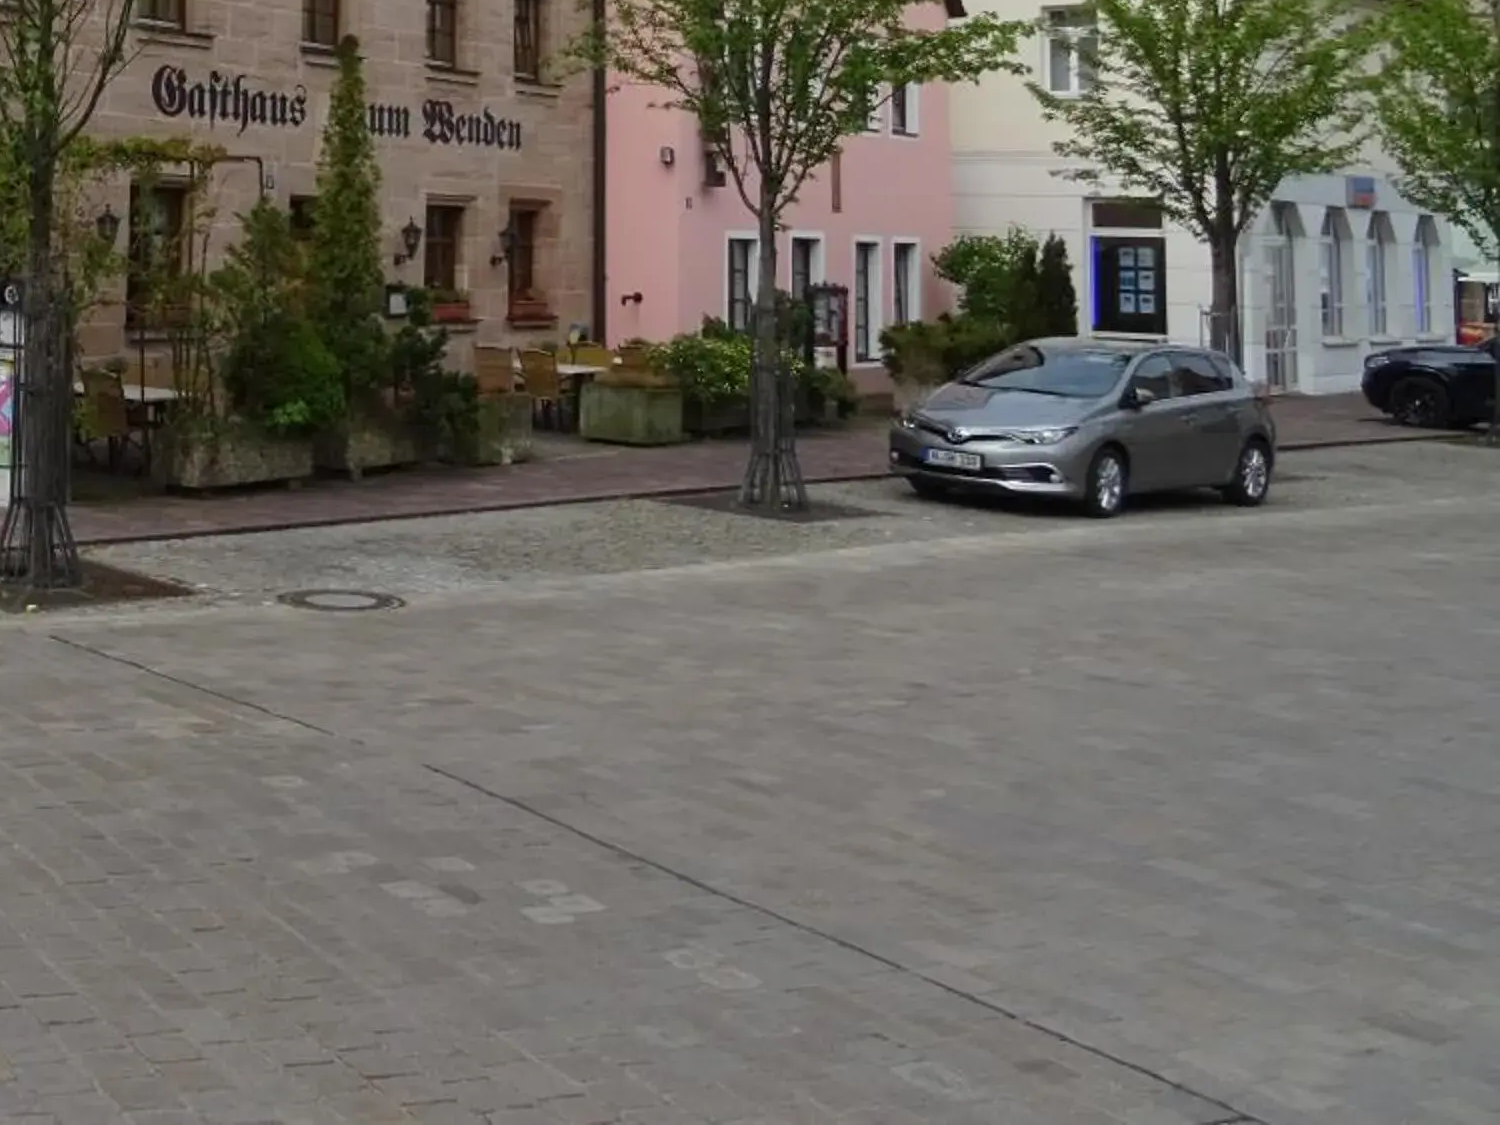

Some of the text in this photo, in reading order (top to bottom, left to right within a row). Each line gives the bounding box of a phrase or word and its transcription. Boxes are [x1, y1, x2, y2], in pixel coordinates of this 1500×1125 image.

[152, 63, 522, 151] Gasthaus um Wenden
